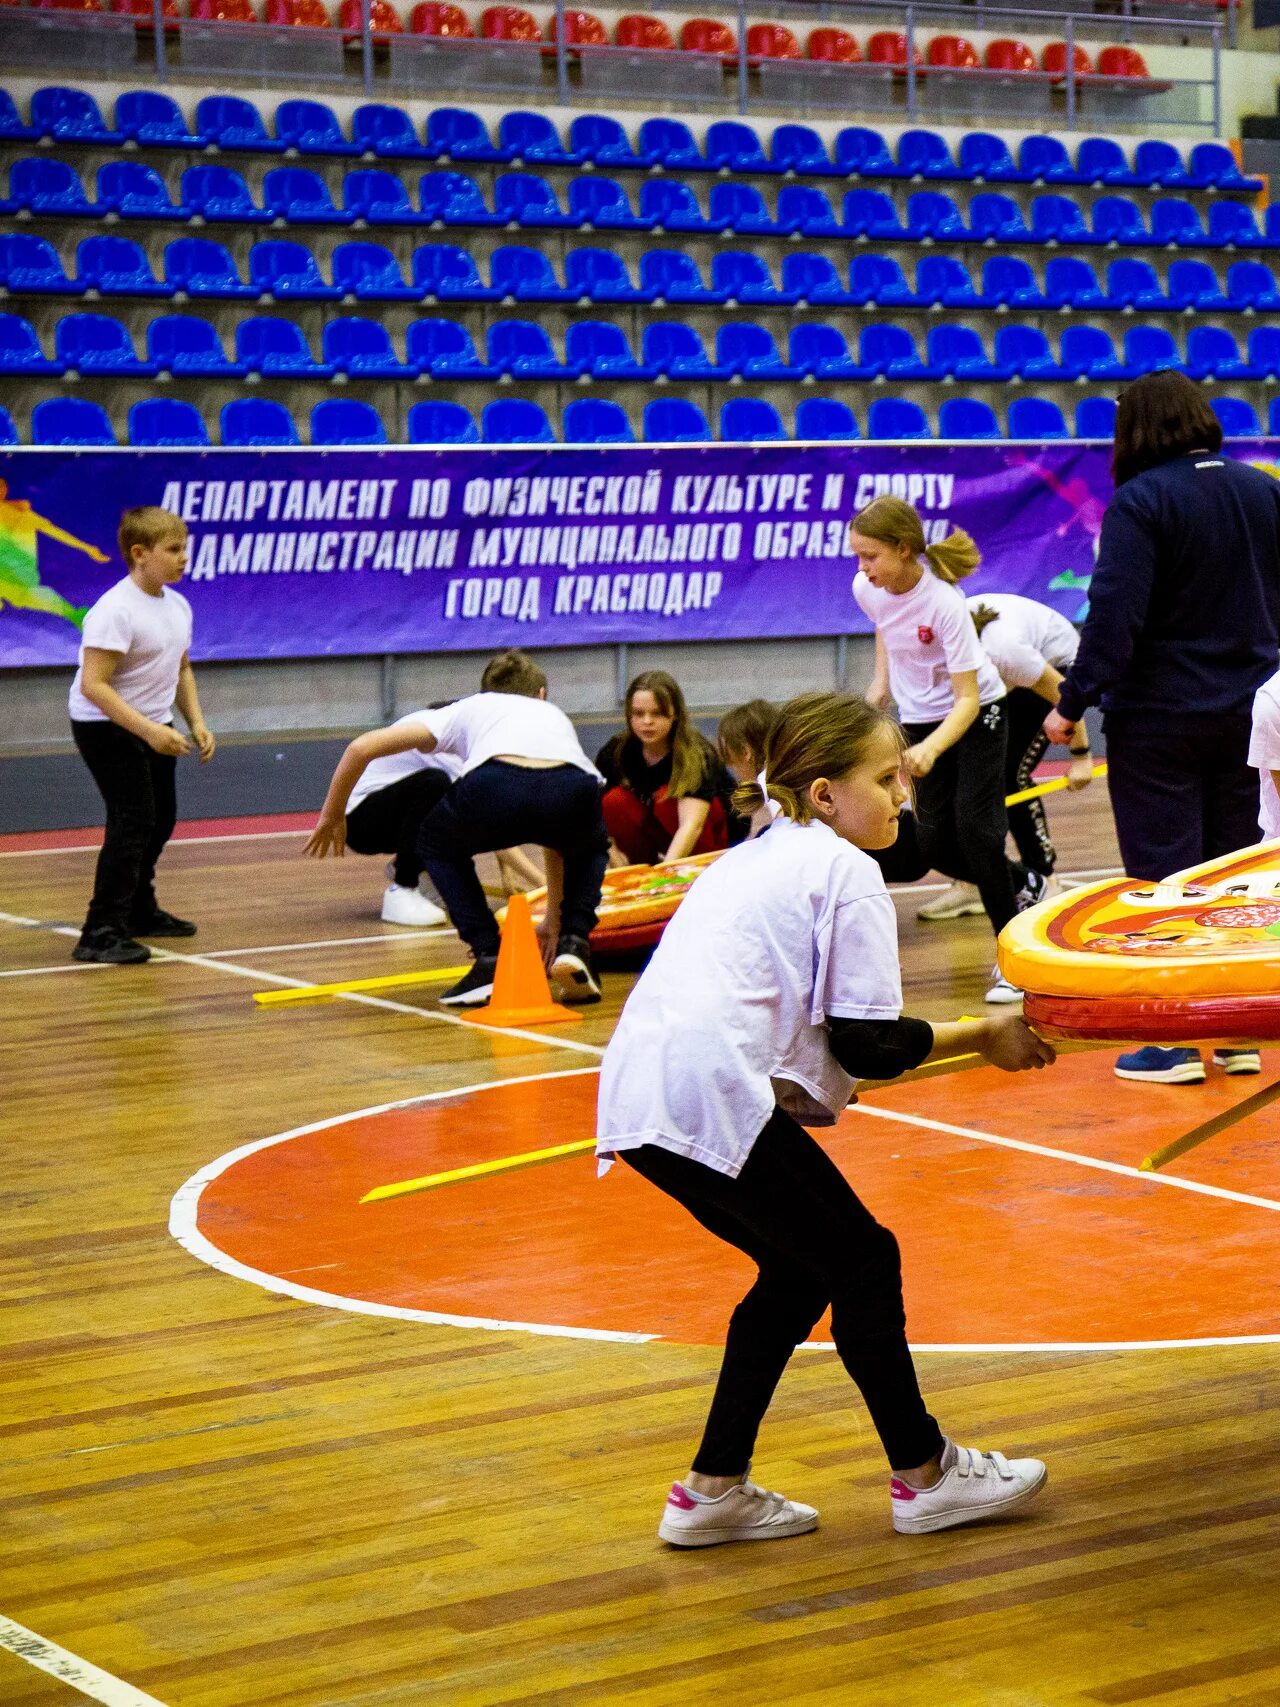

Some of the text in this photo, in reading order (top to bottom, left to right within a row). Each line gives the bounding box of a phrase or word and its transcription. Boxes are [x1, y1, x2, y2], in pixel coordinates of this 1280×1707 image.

[160, 480, 398, 522] ДЕПАРТАМЕНТ
[408, 478, 450, 519] ПО
[463, 469, 662, 517] ФИЗИЧЕСКОЙ
[671, 474, 813, 513] КУЛЬТУРЕ
[822, 474, 845, 511] И
[468, 522, 742, 571] МУНИЦИПАЛЬНОГО
[445, 571, 722, 622] ГОРОД КРАСНОДАР
